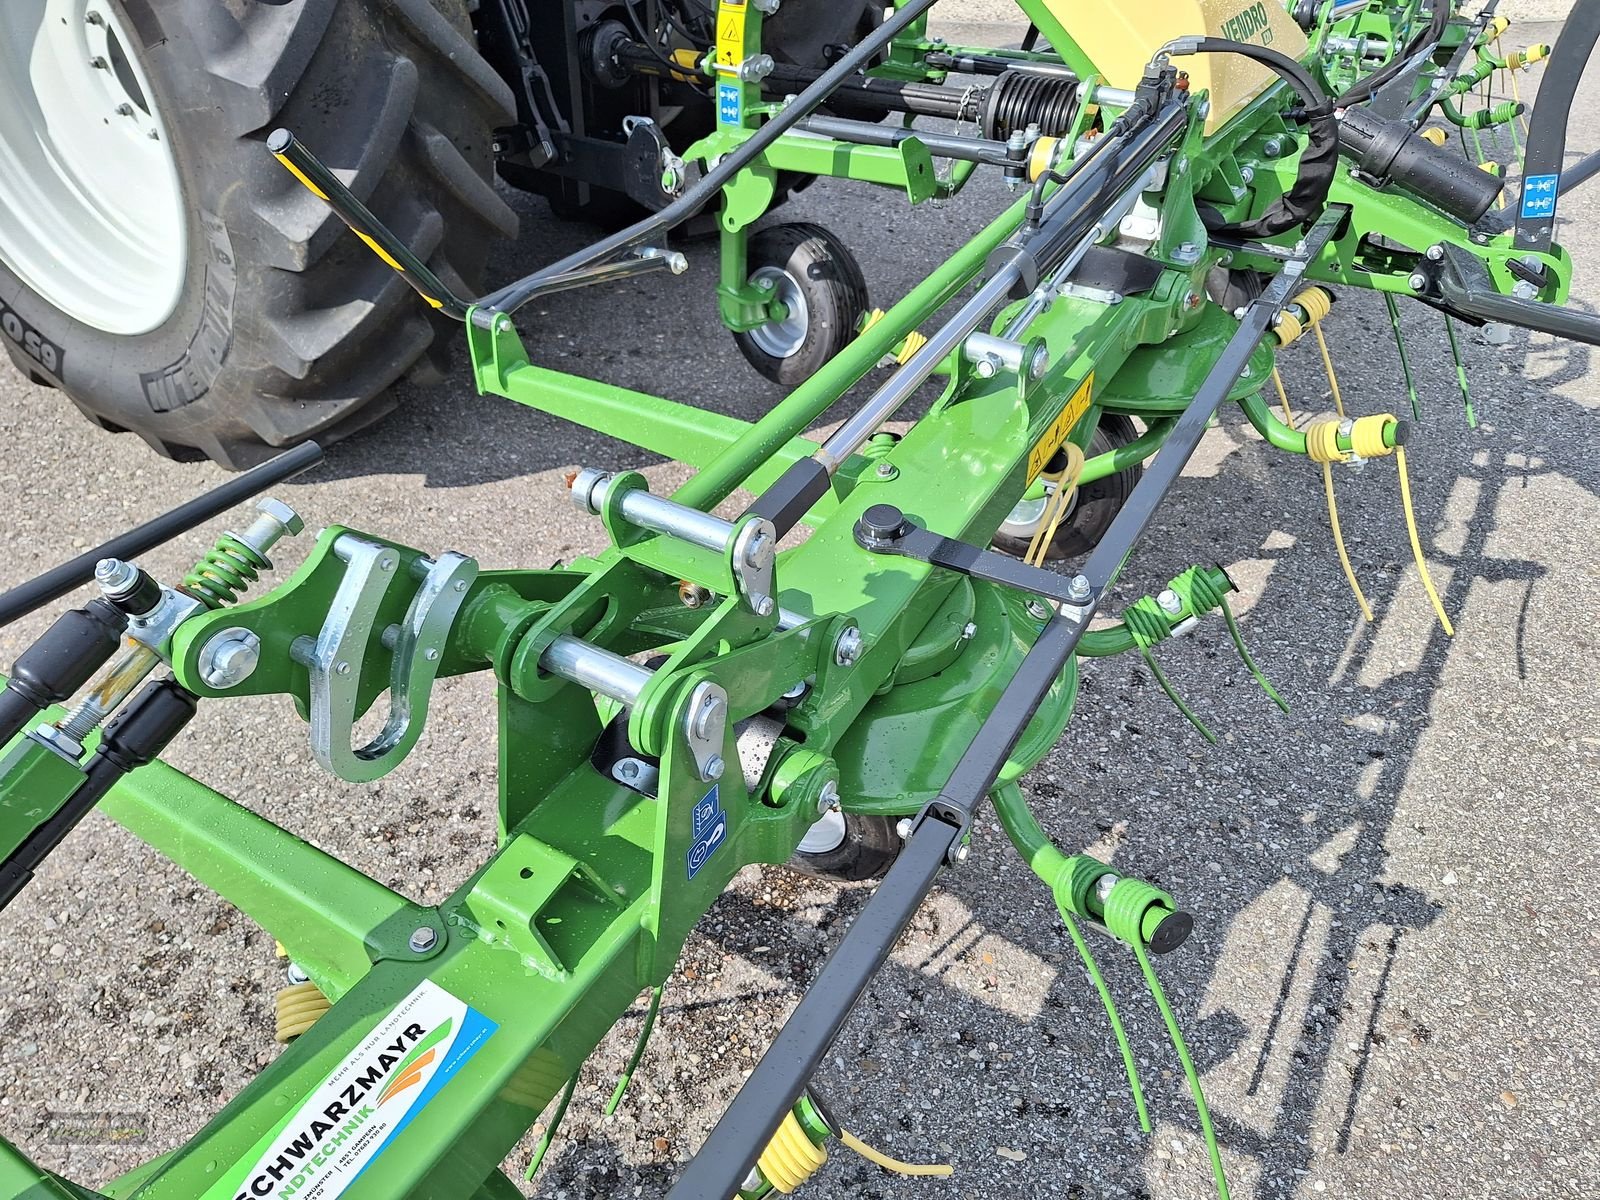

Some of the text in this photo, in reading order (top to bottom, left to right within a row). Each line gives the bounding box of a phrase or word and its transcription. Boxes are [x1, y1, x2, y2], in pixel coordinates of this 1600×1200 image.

[1220, 1, 1268, 43] VENDRO
[0, 307, 57, 373] 650
[328, 1066, 349, 1087] MEHR
[350, 1051, 365, 1066] ALS
[364, 1036, 380, 1051] NUR
[351, 1124, 377, 1151] GAMPERN
